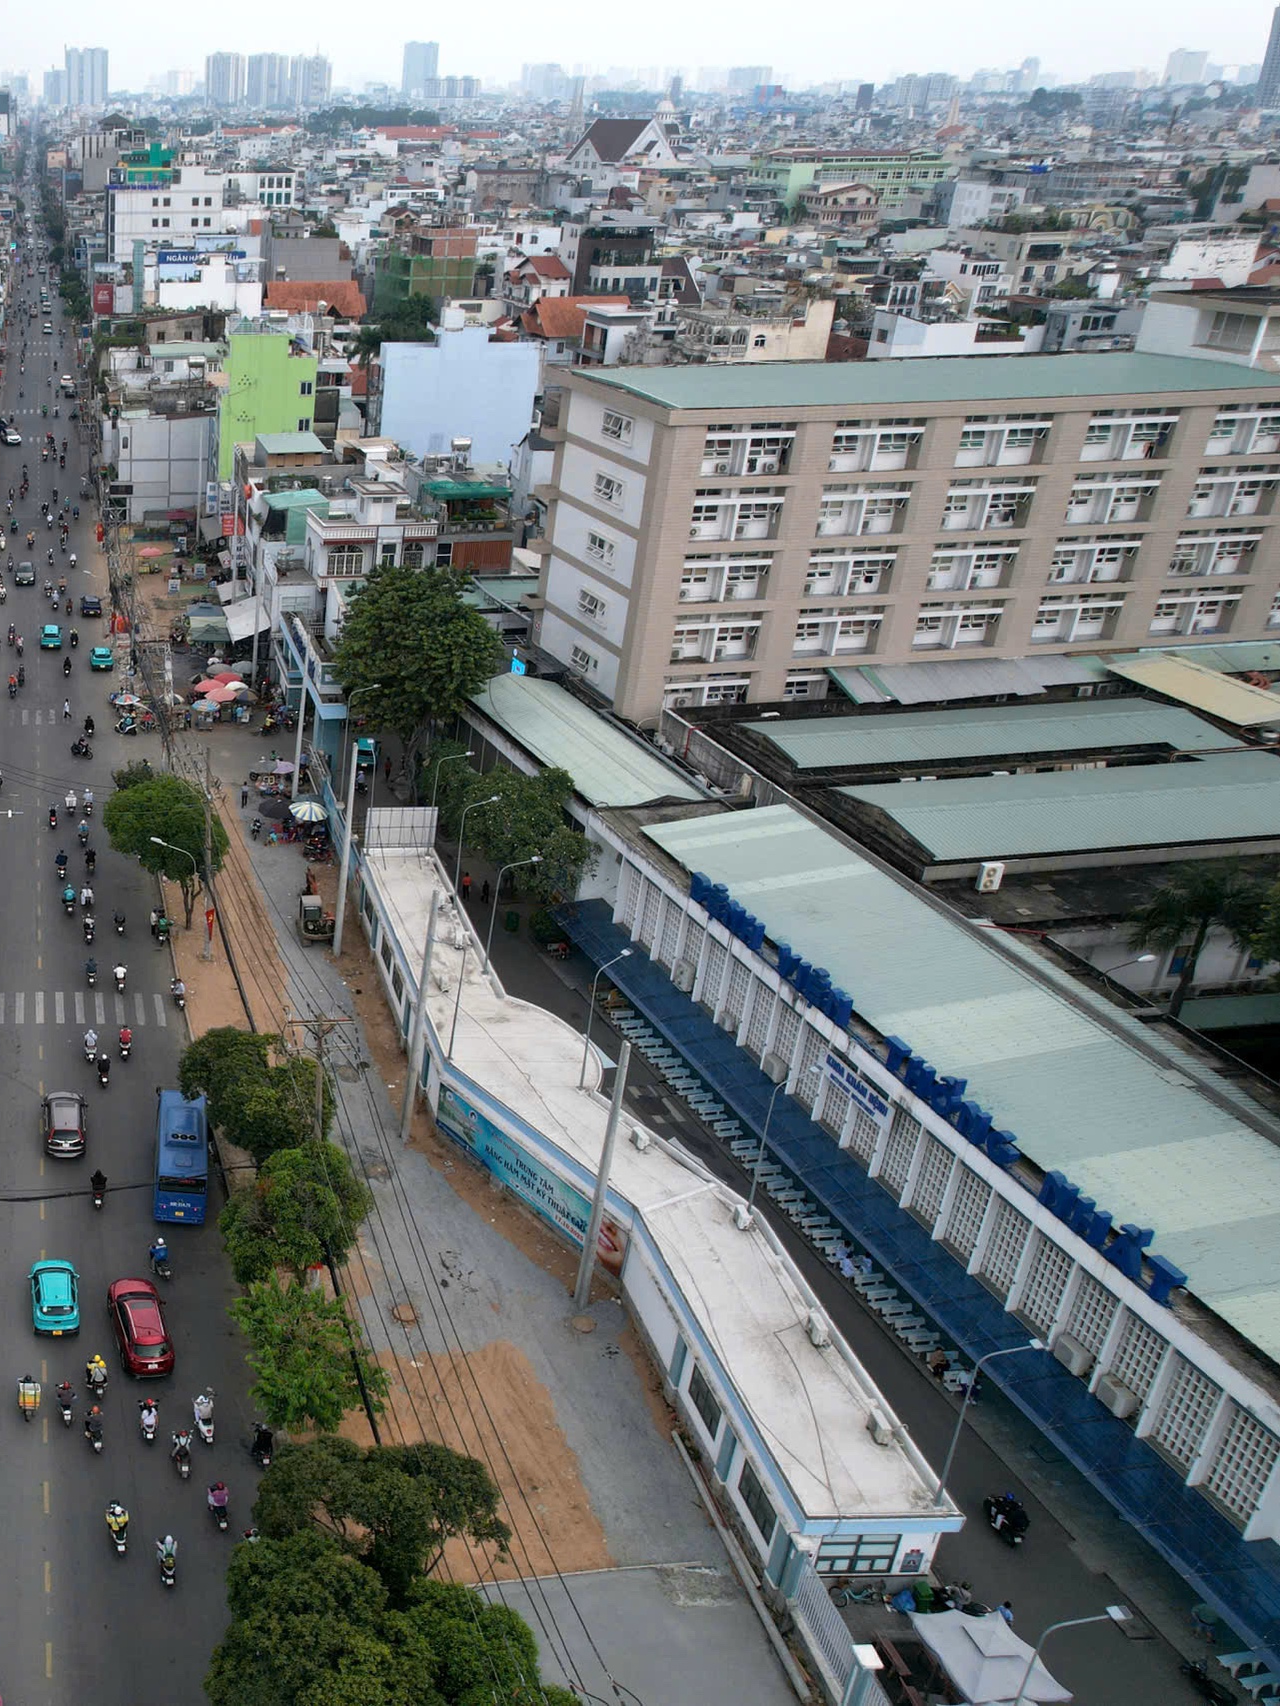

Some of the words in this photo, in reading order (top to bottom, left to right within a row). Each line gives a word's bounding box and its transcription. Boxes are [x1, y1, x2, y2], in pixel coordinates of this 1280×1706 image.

[166, 253, 188, 262] NGÂN
[485, 1144, 502, 1163] RĂNG
[504, 1159, 519, 1178] HÀM
[521, 1174, 535, 1189] MẶT
[547, 1195, 571, 1220] THUẬT
[516, 1158, 537, 1181] TRUNG
[540, 1177, 553, 1194] TÂM
[1039, 1169, 1188, 1309] NHẤT
